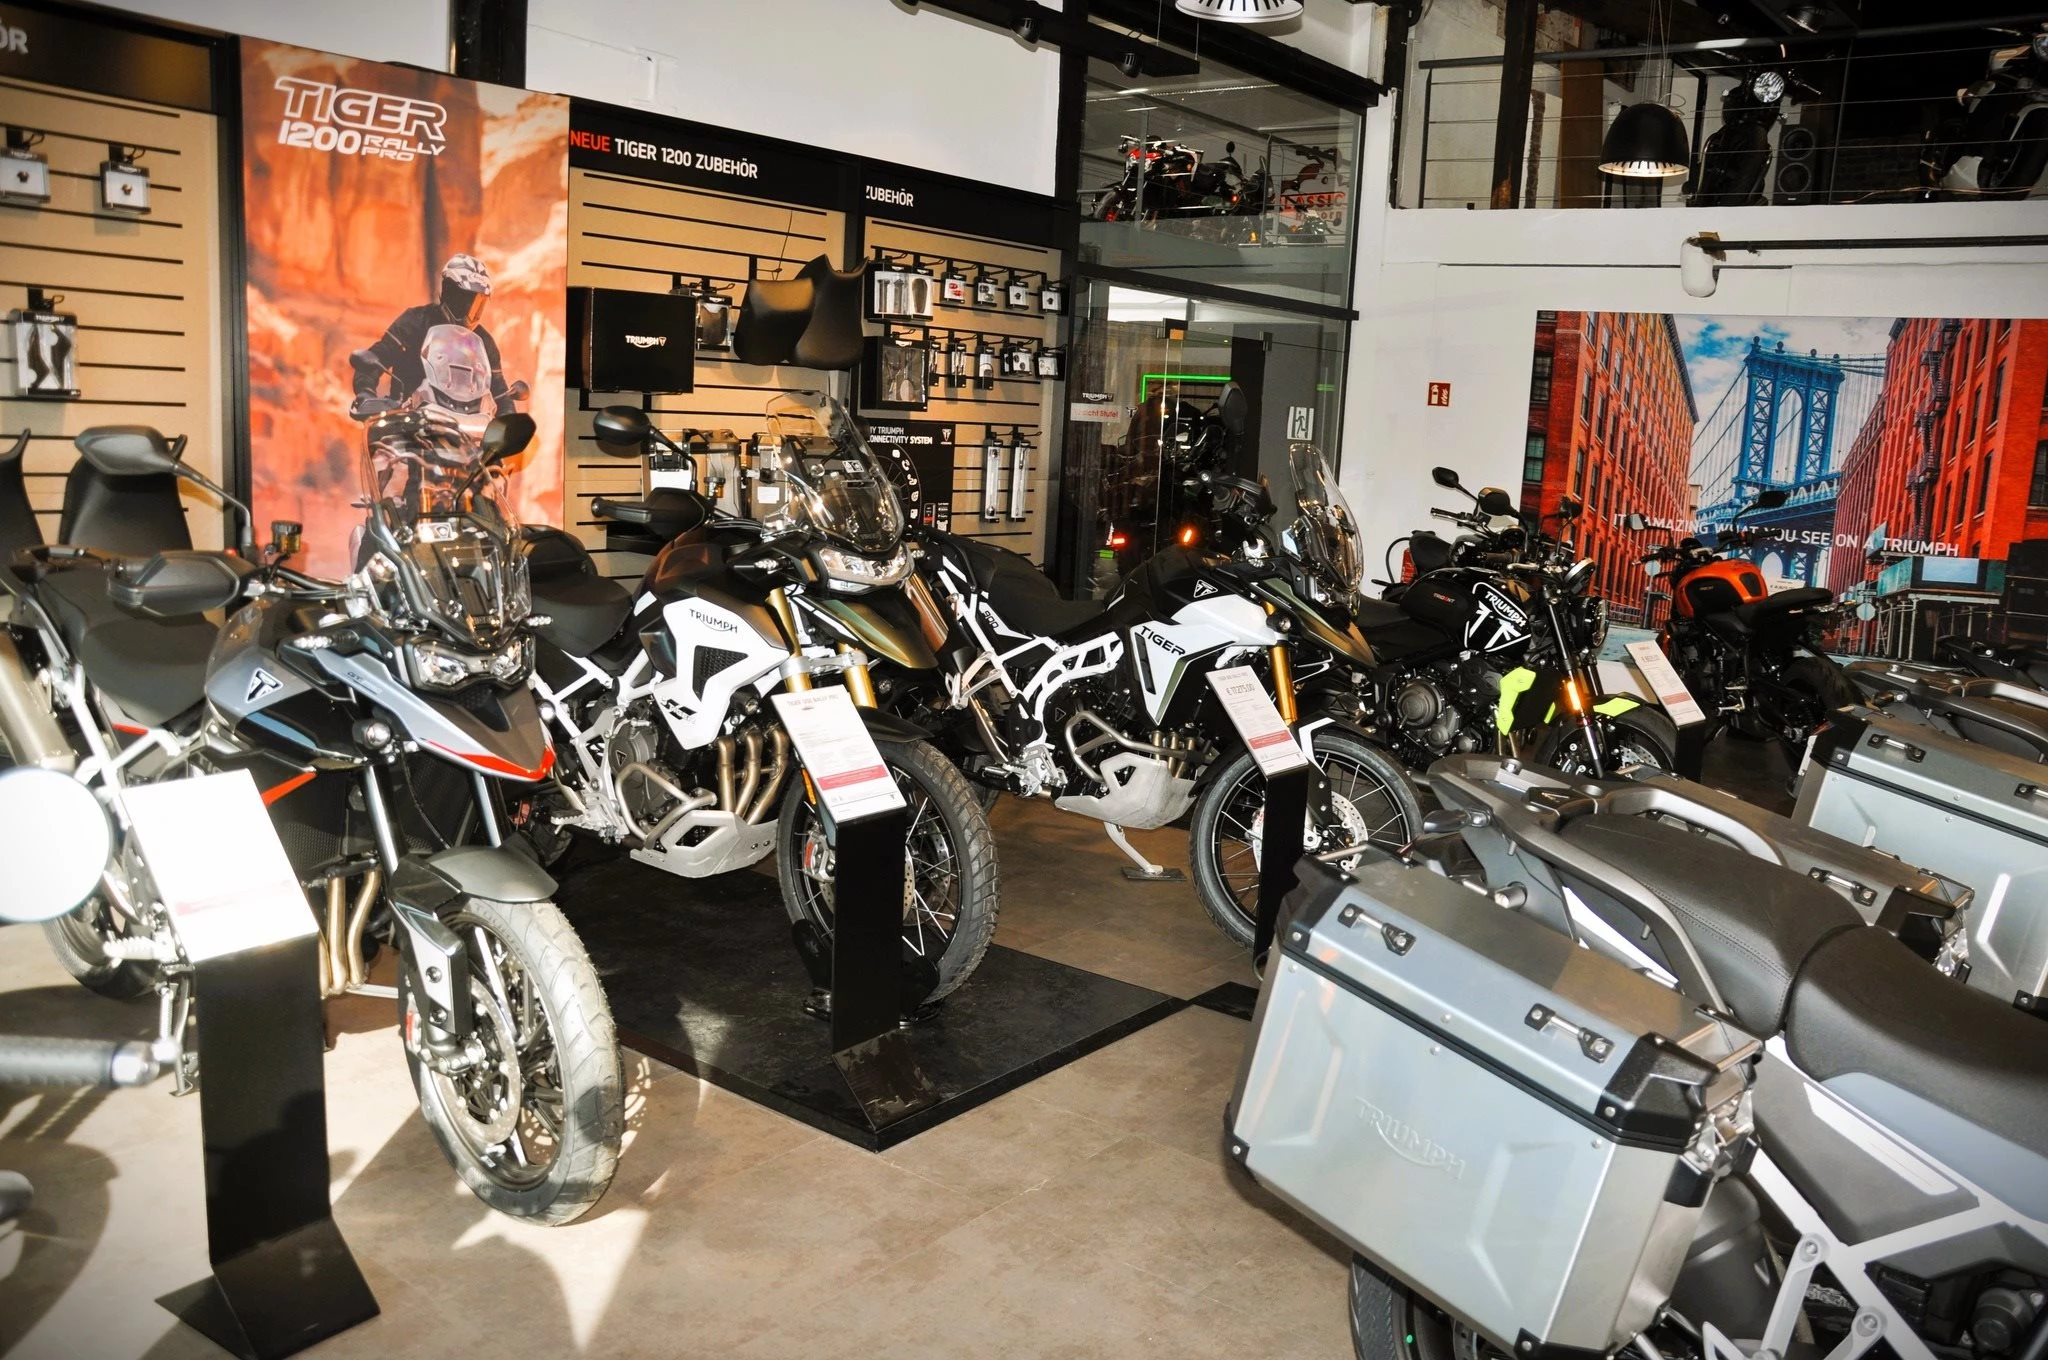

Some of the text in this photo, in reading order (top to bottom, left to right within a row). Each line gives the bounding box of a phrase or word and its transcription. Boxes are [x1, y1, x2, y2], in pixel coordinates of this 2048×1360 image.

[274, 76, 447, 142] TIGER
[278, 119, 362, 155] 1200
[363, 134, 446, 156] RALLY
[361, 147, 414, 162] PRO
[570, 129, 758, 179] NEUE TIGER 1200 ZUBEHÖR
[625, 334, 659, 348] TRIUMPH
[1082, 392, 1107, 401] TRIUMPH
[878, 427, 904, 435] TRIUMPH
[1801, 530, 1831, 546] SEE
[1835, 533, 1858, 548] ON
[1863, 539, 1874, 550] A
[1882, 537, 1959, 557] TRIUMPH
[688, 608, 738, 634] TRIUMPH
[1484, 590, 1527, 628] TRIUMPH
[1141, 625, 1186, 656] TIGER
[1355, 1095, 1466, 1181] TRIUMPH
